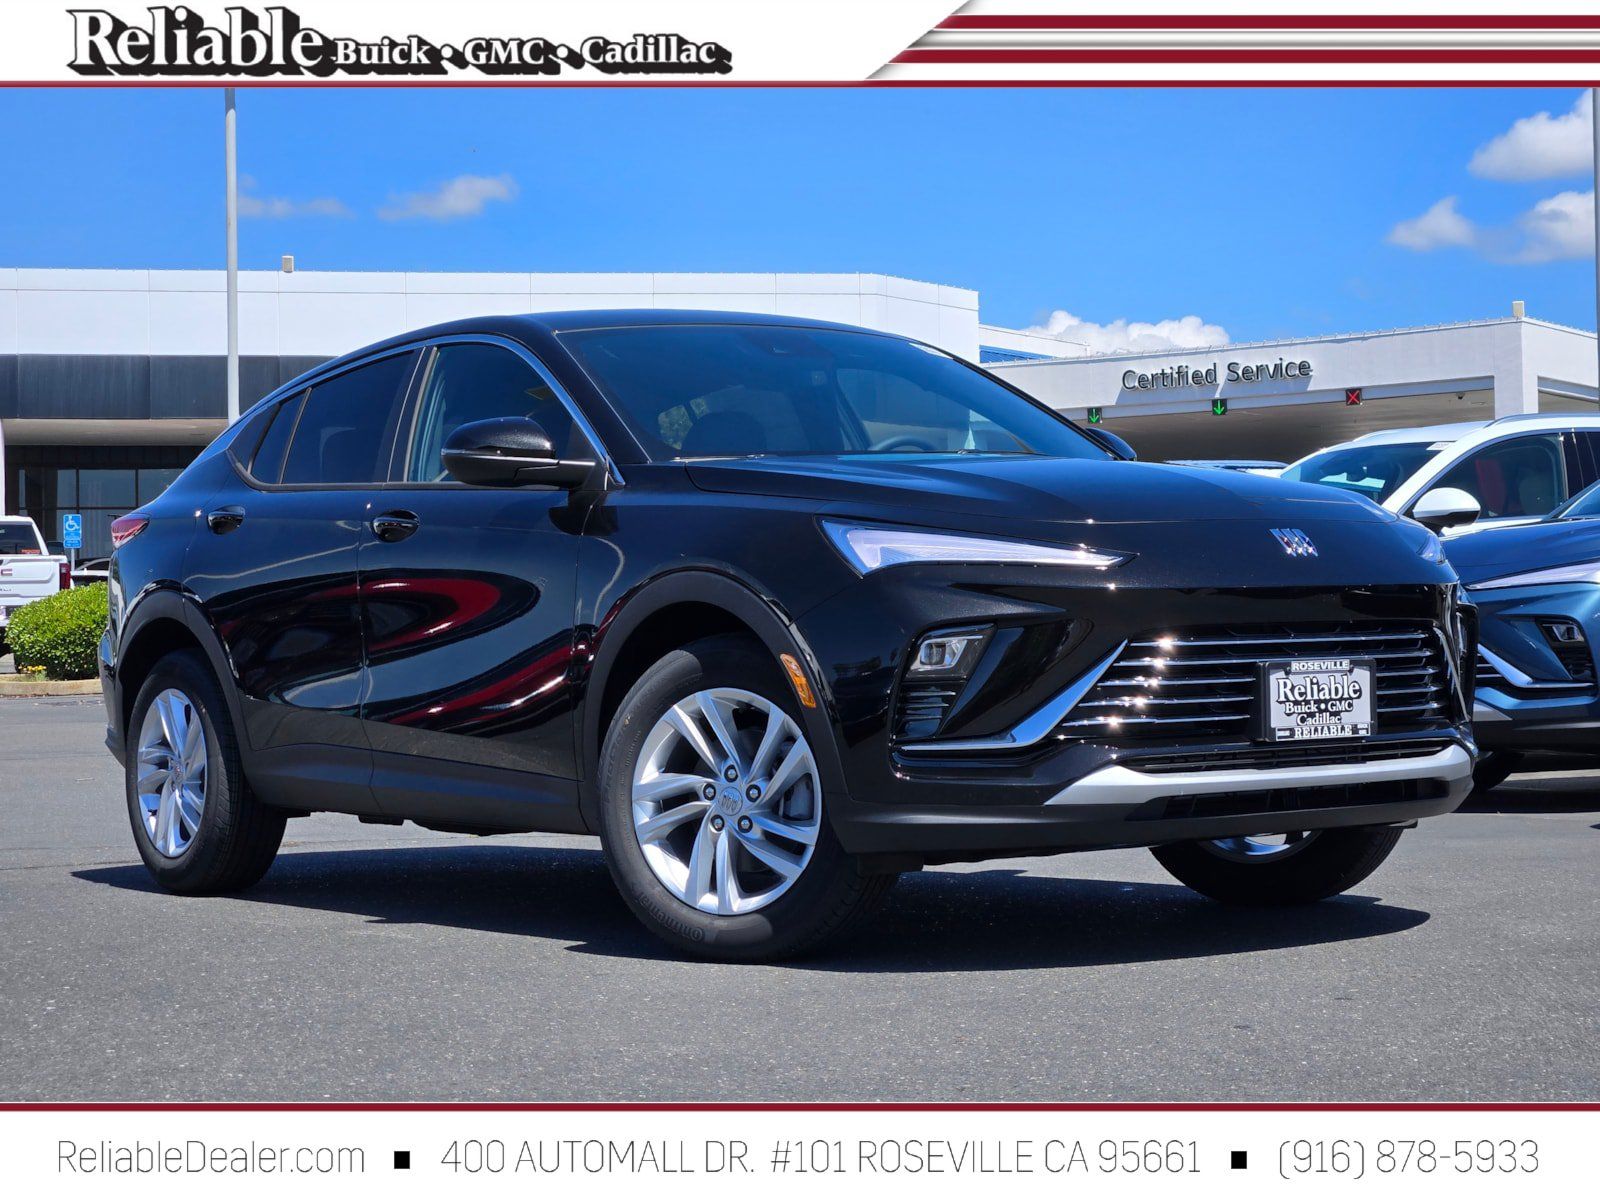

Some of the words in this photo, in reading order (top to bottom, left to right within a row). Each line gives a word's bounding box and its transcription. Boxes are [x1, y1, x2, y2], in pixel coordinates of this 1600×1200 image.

[1122, 362, 1218, 390] Certified
[1227, 357, 1313, 383] Service
[1291, 660, 1349, 671] ROSEVILLE
[1276, 674, 1362, 702] Reliable
[1284, 701, 1318, 714] Buick
[1327, 700, 1353, 712] GMC
[1296, 712, 1342, 725] Cadillac
[1294, 725, 1352, 739] RELIABLE
